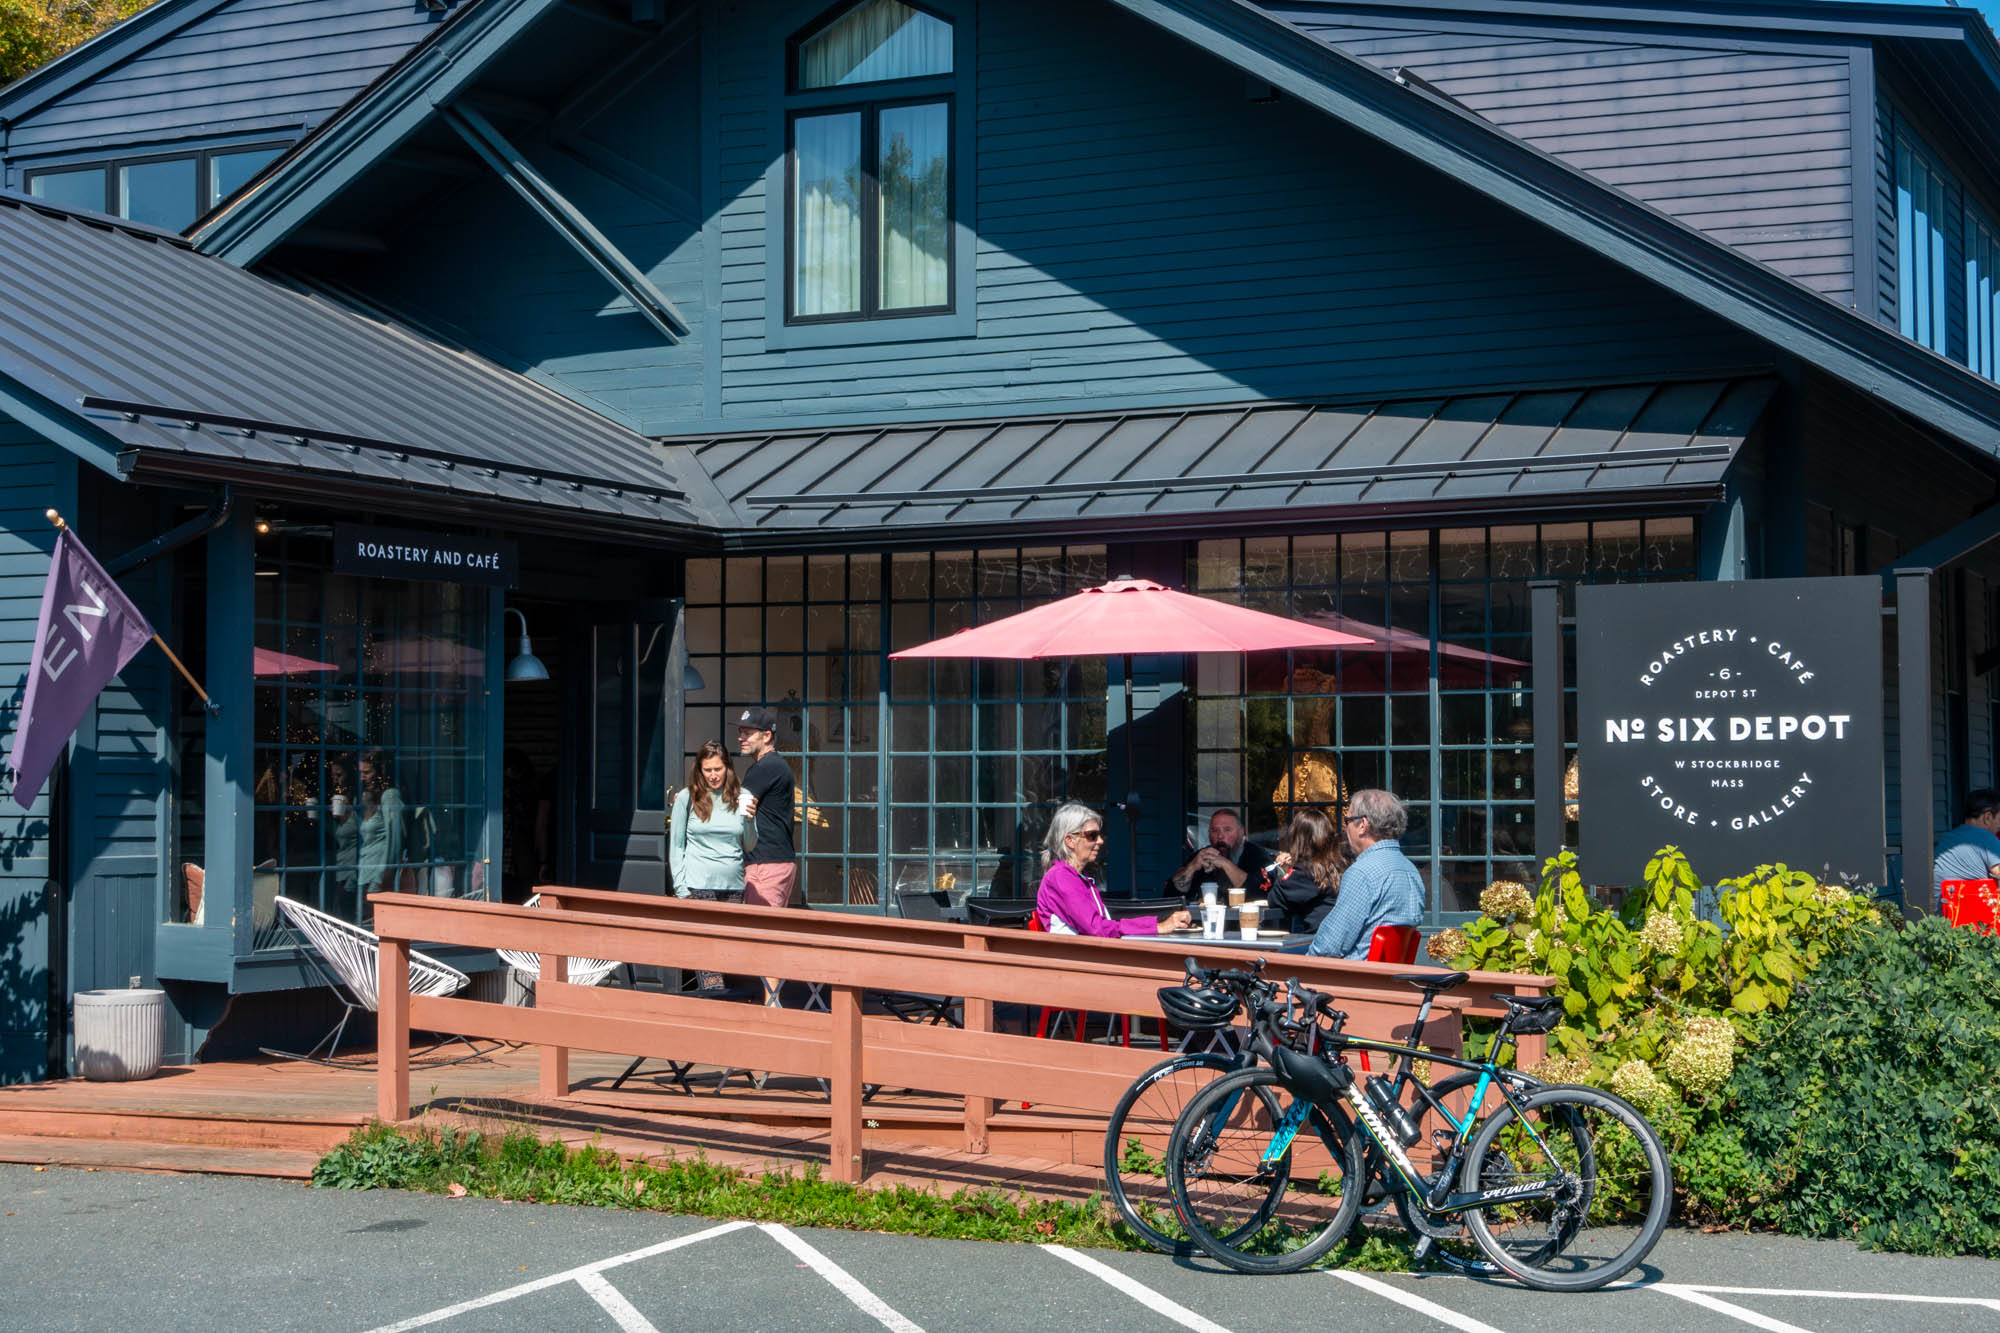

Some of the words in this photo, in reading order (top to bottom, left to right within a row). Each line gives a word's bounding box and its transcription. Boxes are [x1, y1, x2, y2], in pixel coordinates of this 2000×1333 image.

[357, 542, 429, 563] ROASTERY
[433, 550, 462, 566] AND
[466, 552, 500, 570] CAFÉ
[1639, 628, 1738, 687] ROASTERY
[1767, 641, 1815, 685] CAFÉ
[1695, 689, 1737, 699] DEPOT
[1742, 688, 1757, 698] ST
[1657, 716, 1717, 743] SIX
[1729, 714, 1851, 742] DEPOT
[1674, 760, 1686, 769] W
[1690, 759, 1781, 769] STOCKBRIDGE
[1711, 778, 1744, 788] MASS
[1641, 775, 1699, 825] STORE
[1730, 771, 1813, 831] GALLERY
[1479, 1180, 1548, 1200] SPECIALIZED
